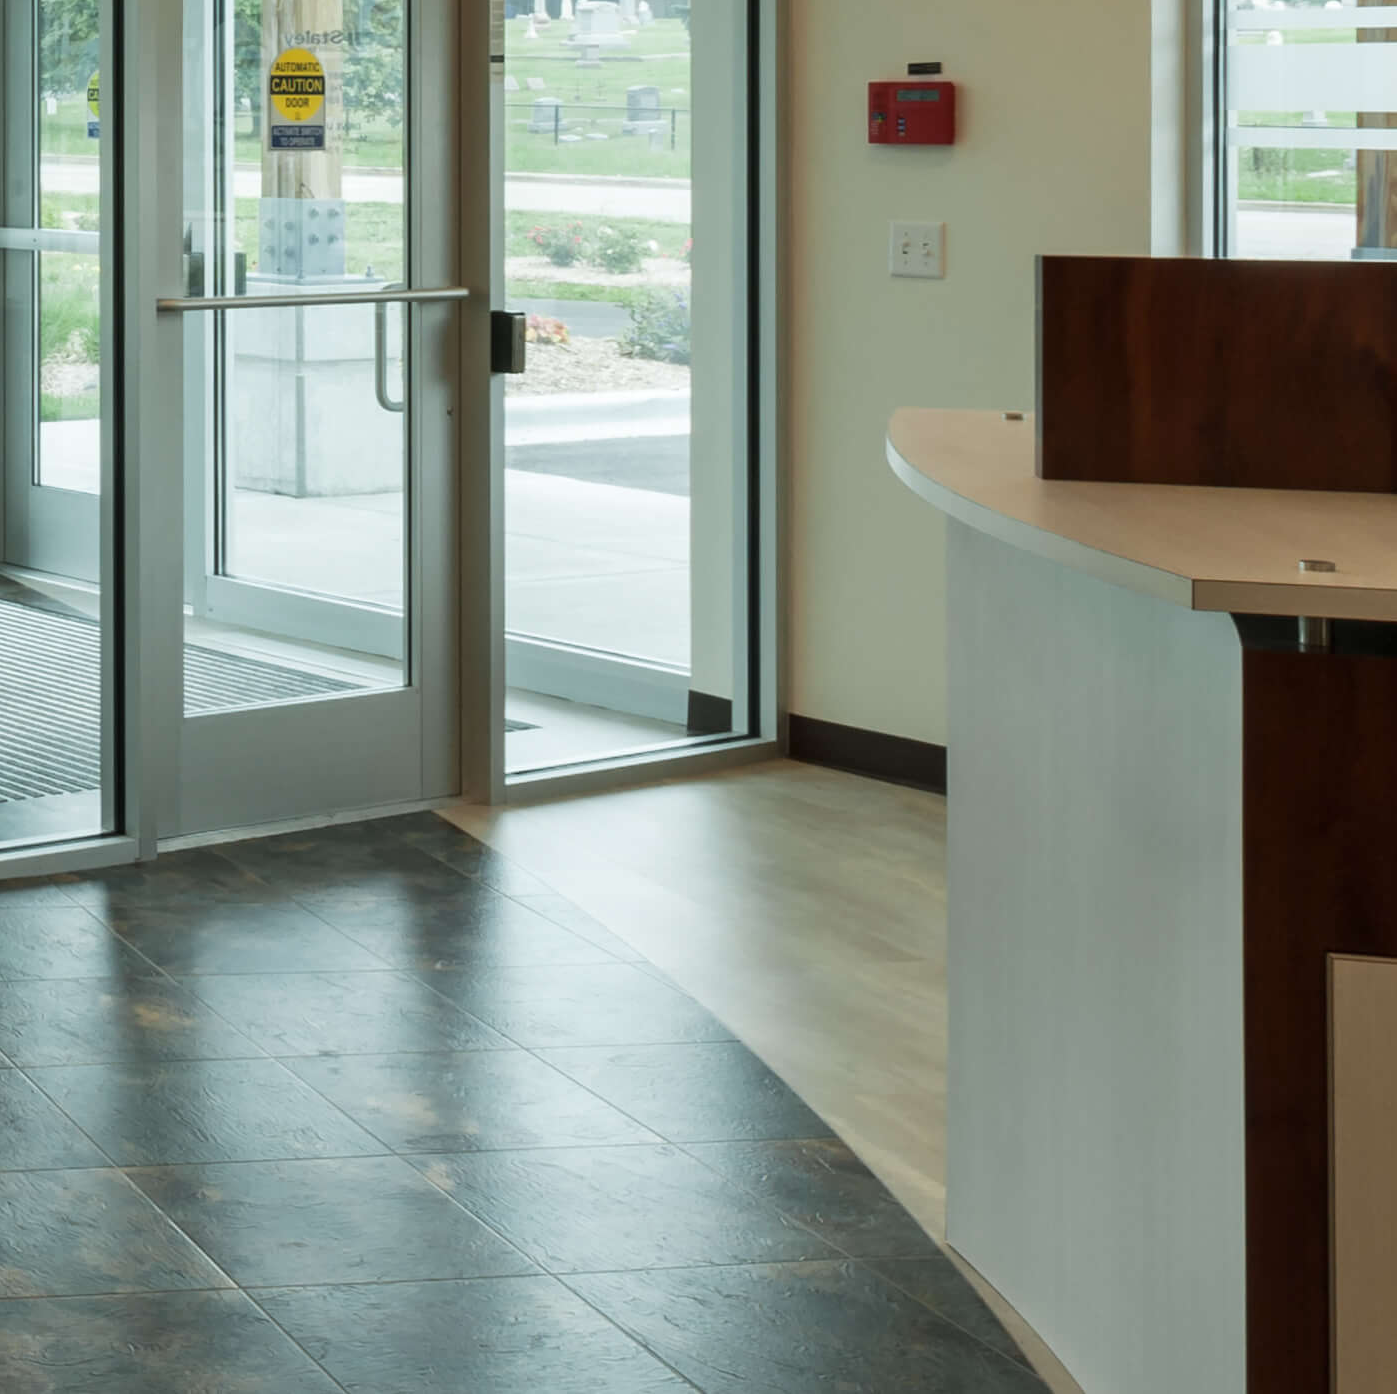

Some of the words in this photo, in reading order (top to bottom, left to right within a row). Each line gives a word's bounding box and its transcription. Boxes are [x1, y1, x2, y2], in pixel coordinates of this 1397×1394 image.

[275, 62, 320, 72] AUTOMATIC
[271, 78, 323, 92] CAUTION
[285, 97, 310, 108] DOOR
